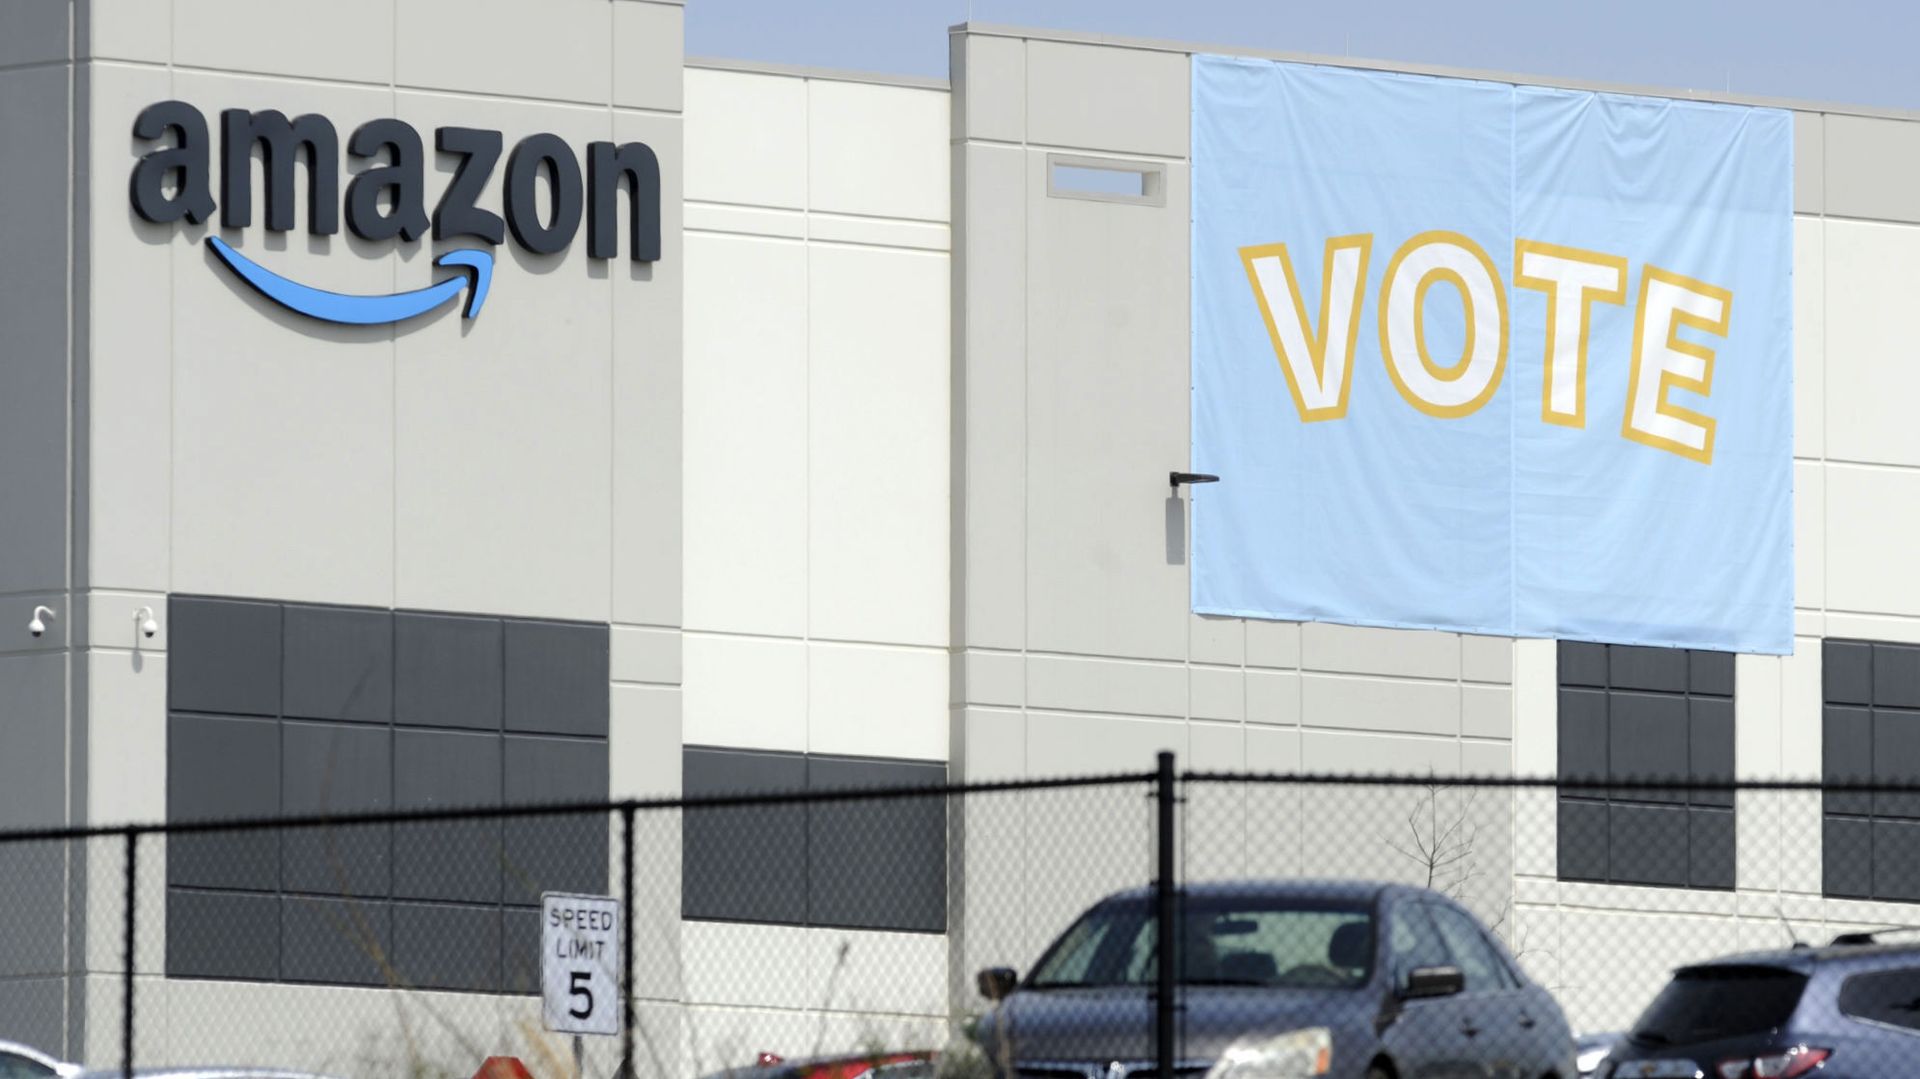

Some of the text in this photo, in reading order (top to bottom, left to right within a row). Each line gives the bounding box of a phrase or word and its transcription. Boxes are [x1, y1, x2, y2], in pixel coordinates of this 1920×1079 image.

[130, 100, 661, 262] amazon
[1237, 230, 1733, 466] VOTE
[550, 908, 612, 931] SPEED
[556, 938, 605, 960] LIMIT
[568, 971, 594, 1020] 5
